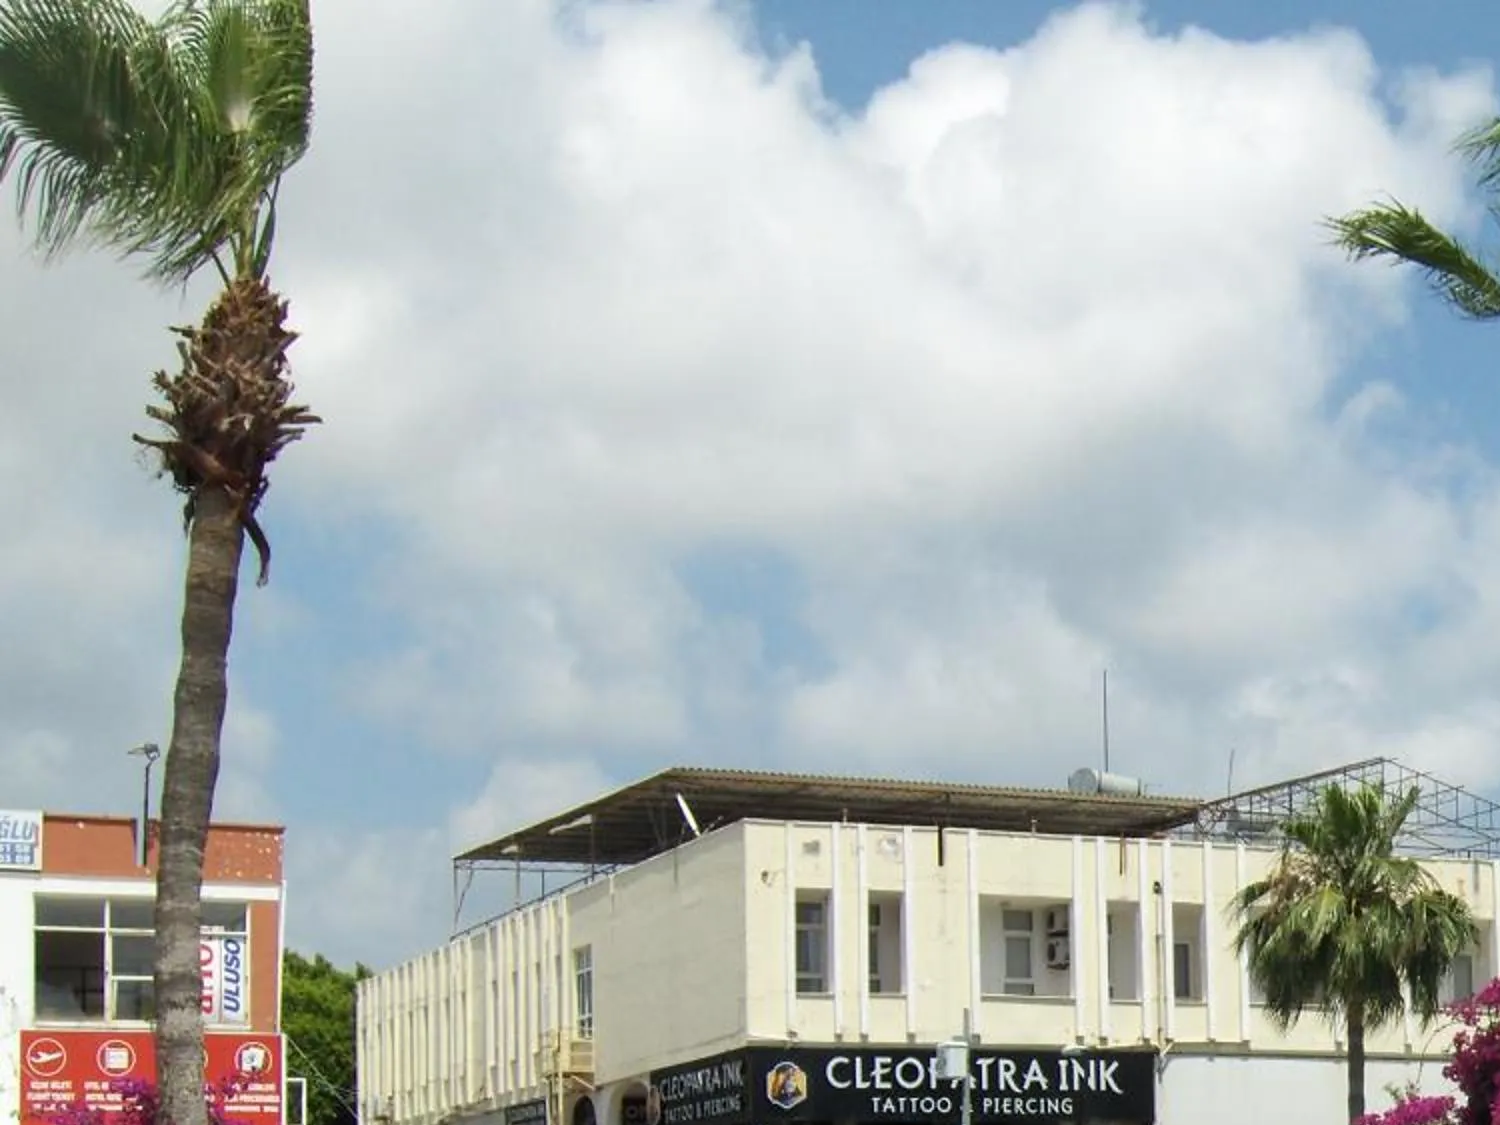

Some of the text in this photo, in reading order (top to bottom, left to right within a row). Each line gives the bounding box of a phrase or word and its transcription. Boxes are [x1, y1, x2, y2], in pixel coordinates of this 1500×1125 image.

[722, 1060, 744, 1088] INK
[825, 1056, 1123, 1094] CLEOTRA INK
[872, 1097, 952, 1113] TATTOO
[983, 1098, 1073, 1114] PIERCING
